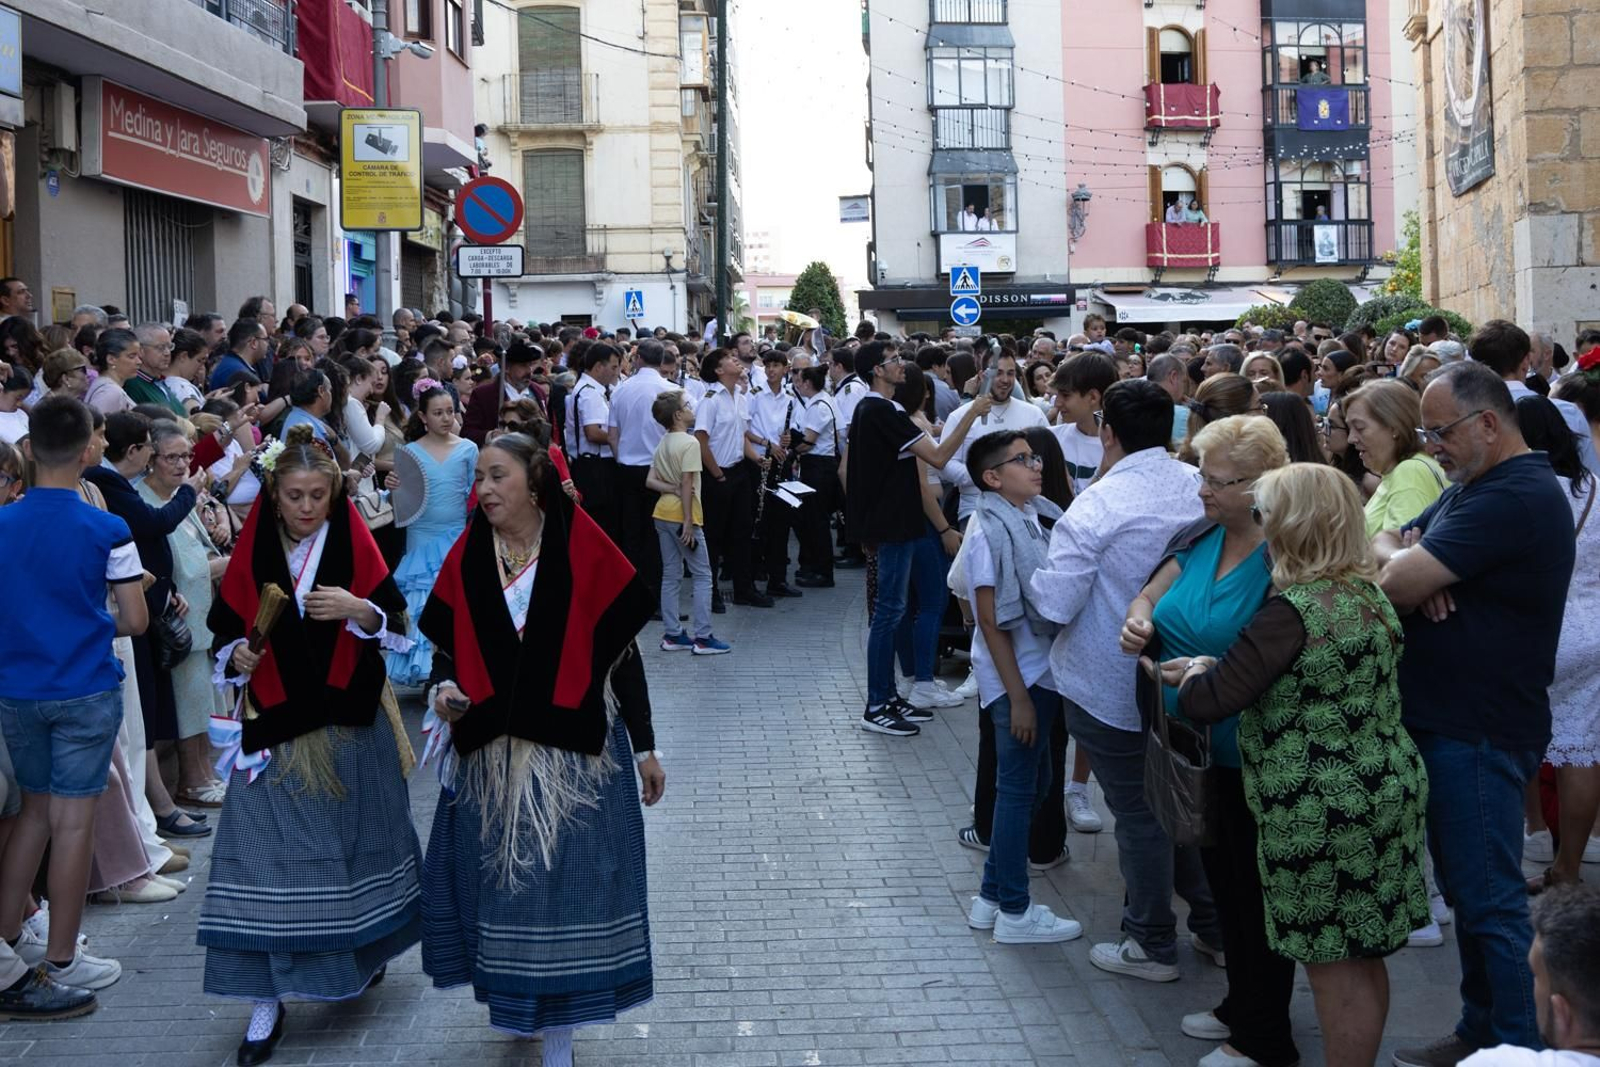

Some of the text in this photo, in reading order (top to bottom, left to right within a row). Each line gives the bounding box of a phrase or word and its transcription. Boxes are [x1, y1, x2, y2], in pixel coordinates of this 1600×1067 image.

[110, 95, 248, 170] Medina y Jara Seguros
